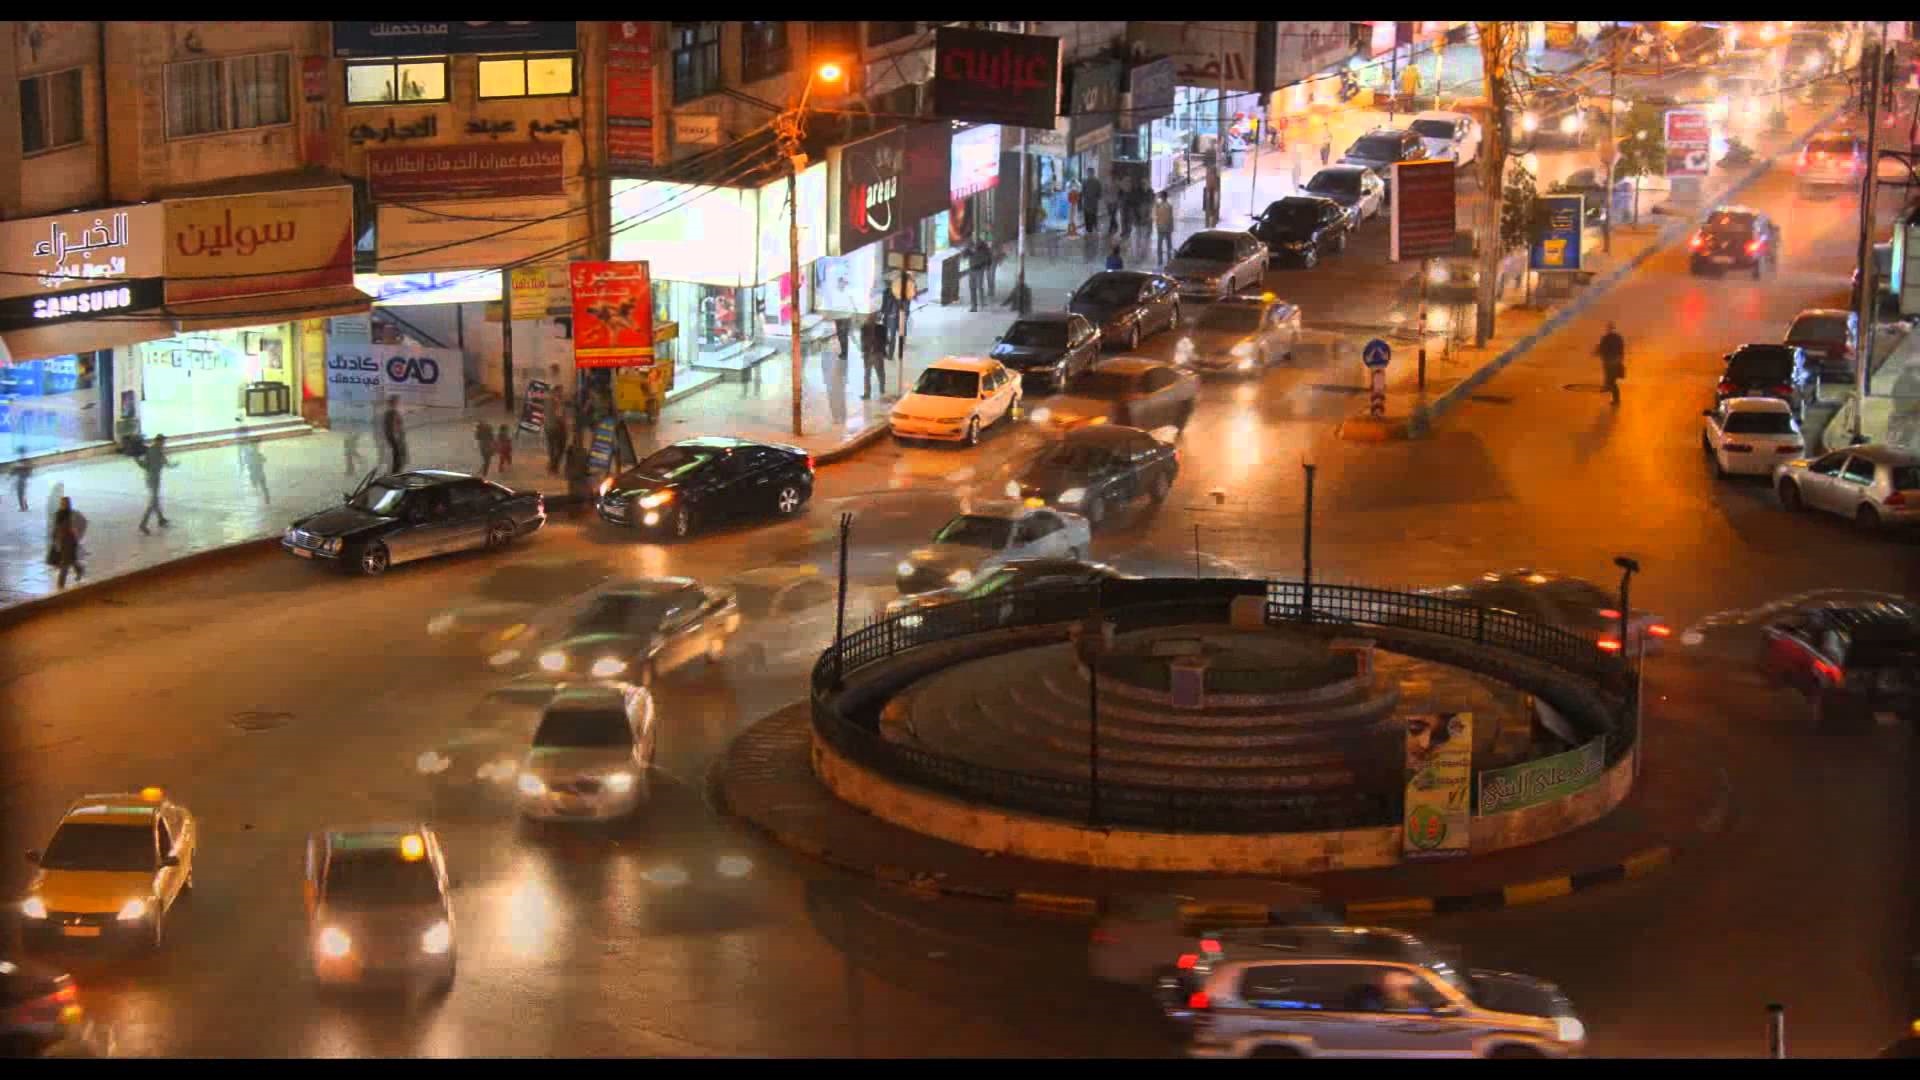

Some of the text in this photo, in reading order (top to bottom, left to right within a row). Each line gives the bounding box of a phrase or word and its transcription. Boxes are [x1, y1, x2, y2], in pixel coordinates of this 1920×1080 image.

[33, 213, 128, 265] الخبراء
[176, 209, 295, 257] سولين
[33, 287, 131, 319] SAMSUNG
[386, 356, 439, 384] CAD
